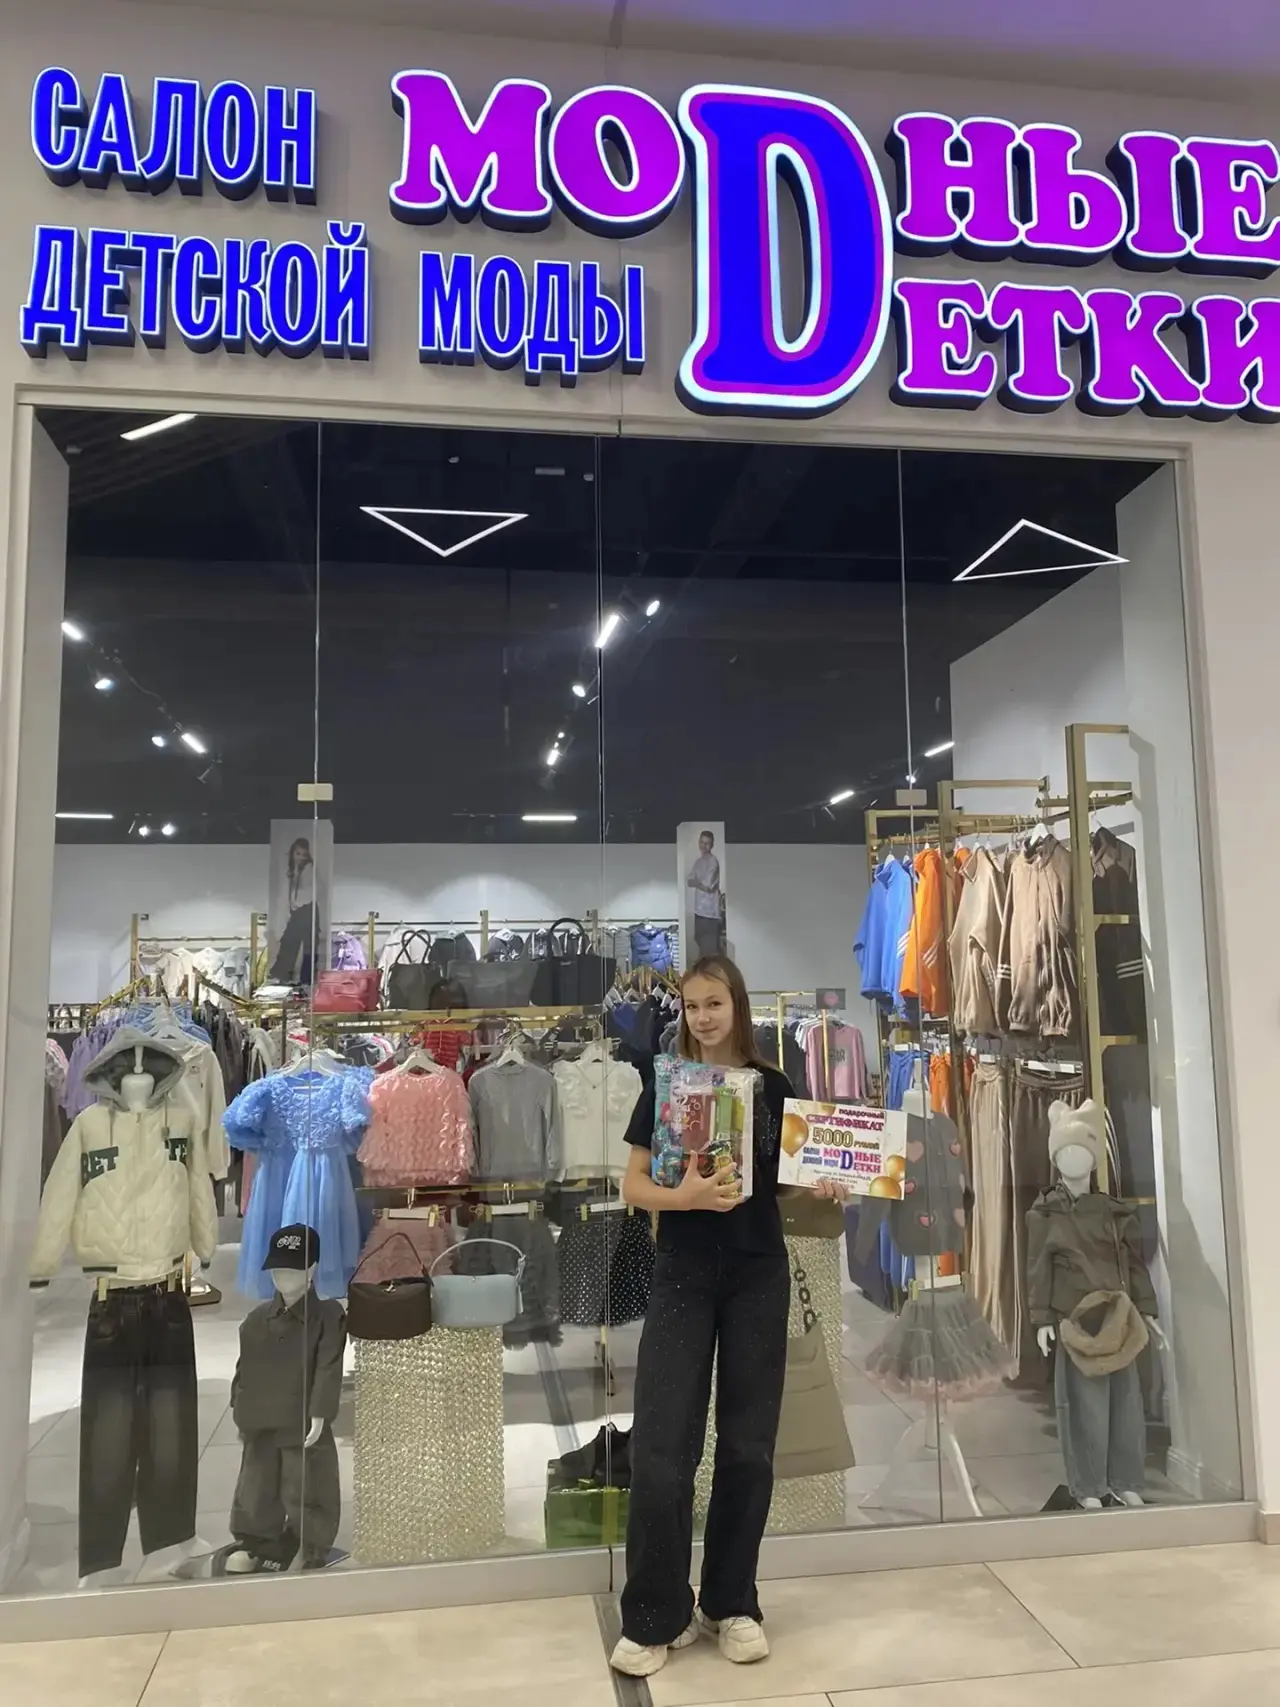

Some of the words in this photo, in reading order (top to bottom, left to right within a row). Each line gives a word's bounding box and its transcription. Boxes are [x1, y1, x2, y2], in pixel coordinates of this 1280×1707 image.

[31, 66, 316, 190] САЛОН
[20, 221, 369, 347] ДЕТСКОЙ
[419, 251, 645, 375] МОДЫ
[812, 1126, 854, 1148] 5000
